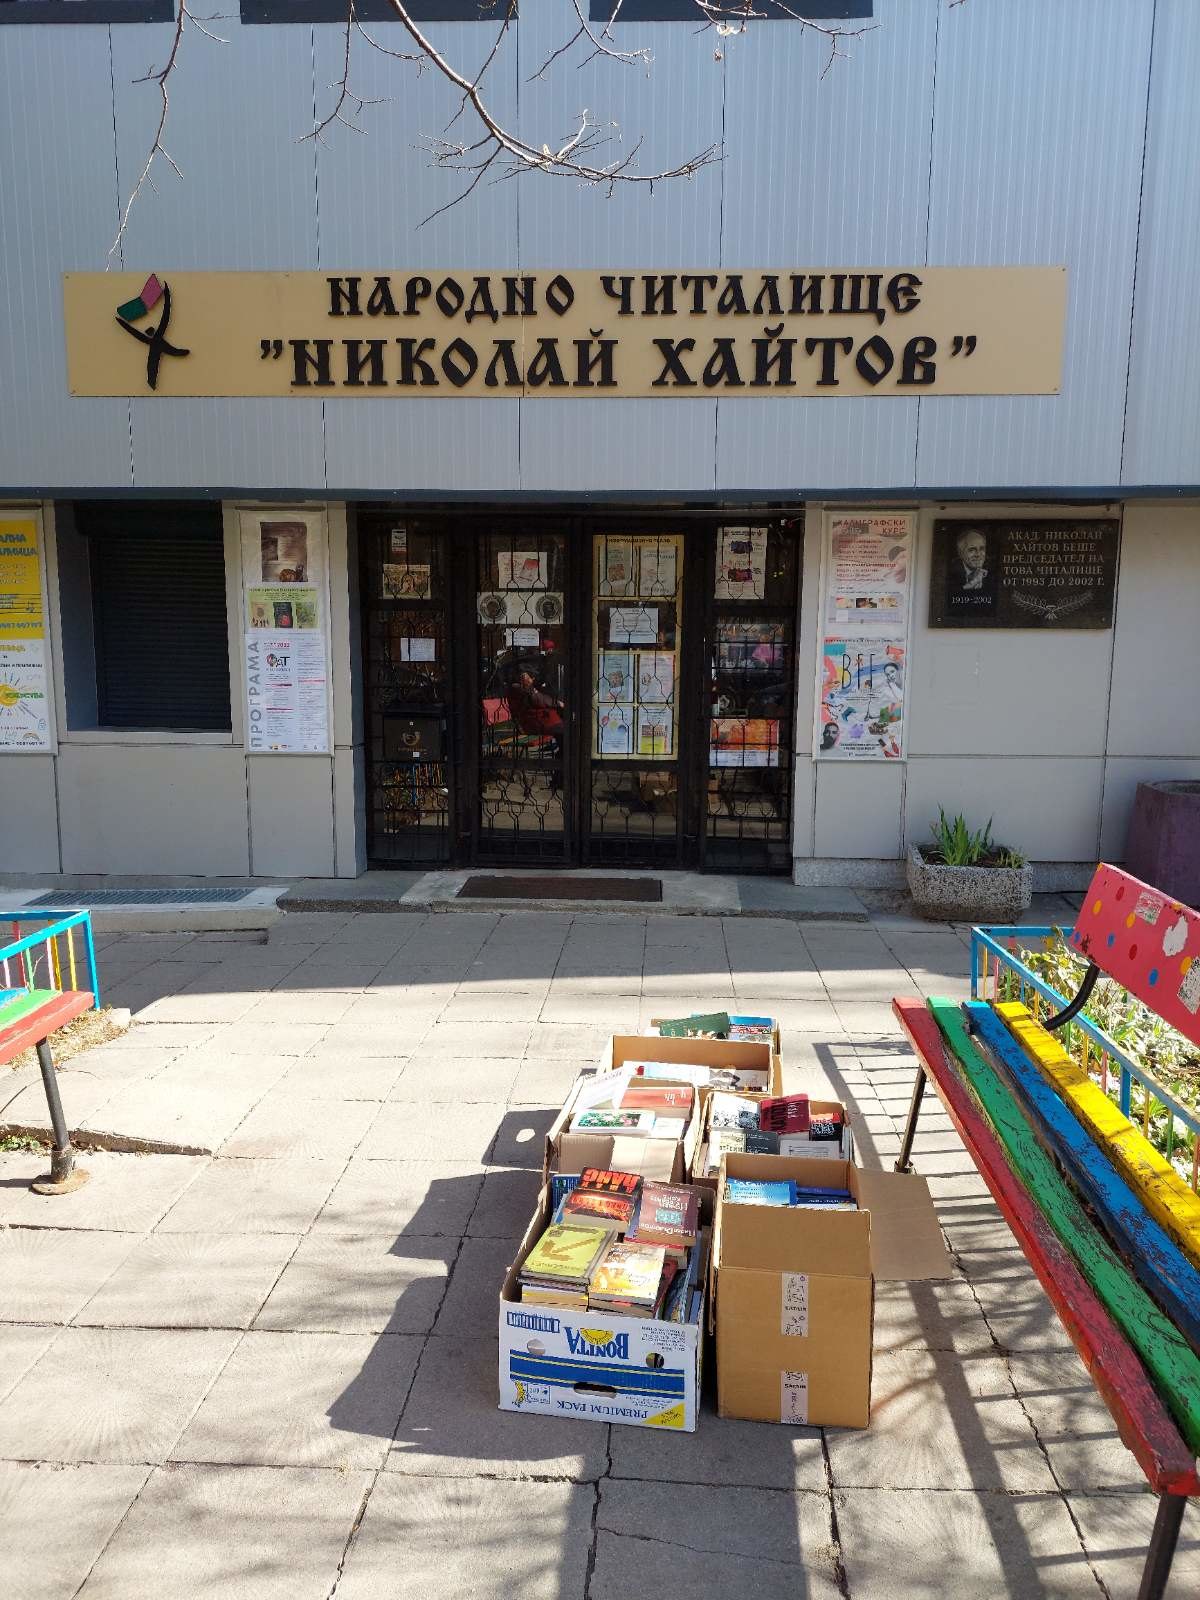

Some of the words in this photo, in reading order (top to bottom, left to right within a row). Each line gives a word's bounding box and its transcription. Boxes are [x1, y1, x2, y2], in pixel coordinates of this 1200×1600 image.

[327, 276, 574, 323] НАРОДНО
[600, 272, 923, 326] ЧИТАЛИЩЕ
[1063, 542, 1096, 552] БЕШЕ
[1002, 554, 1085, 565] ПРЕДСЕДАТЕЛ
[1088, 553, 1105, 563] НА
[1003, 566, 1033, 576] ТОВА
[1002, 577, 1017, 586] ОТ
[1048, 577, 1065, 588] ДО
[1068, 577, 1094, 586] 2002
[247, 641, 263, 748] ПРОГРАМА
[563, 1326, 630, 1360] BONITA
[556, 1400, 587, 1412] PACK
[588, 1403, 648, 1419] PREMIUM
